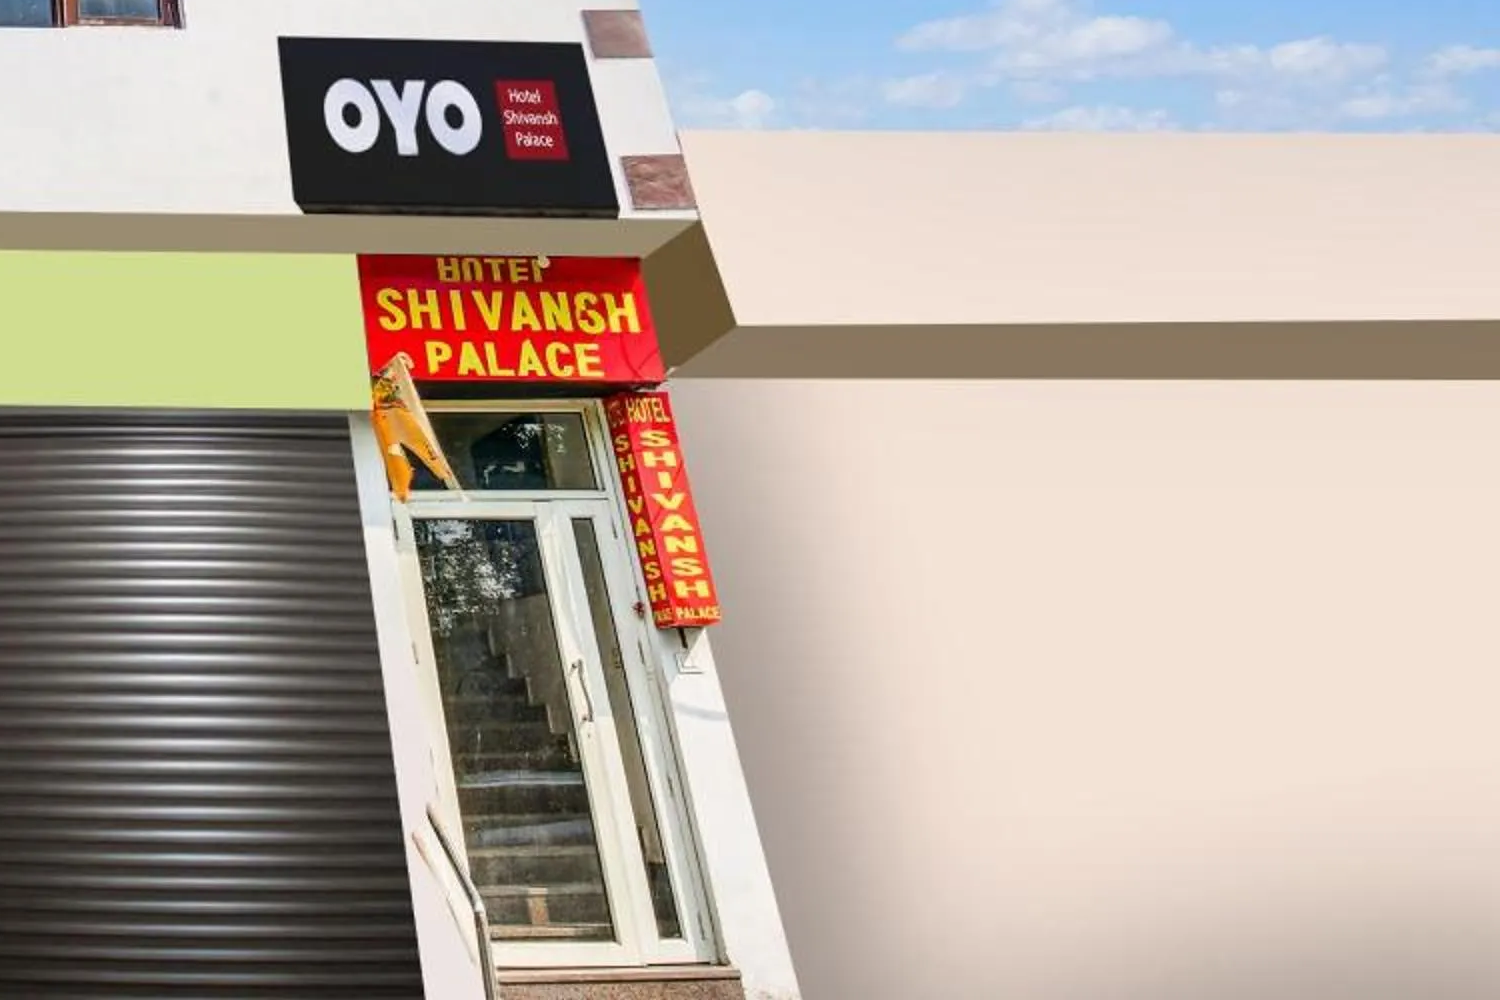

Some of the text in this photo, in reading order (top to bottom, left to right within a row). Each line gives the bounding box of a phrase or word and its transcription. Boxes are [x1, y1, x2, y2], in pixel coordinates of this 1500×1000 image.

[508, 88, 542, 104] Hotel
[323, 77, 483, 156] OYO
[503, 109, 559, 125] Shivansh
[515, 131, 554, 148] Palace
[376, 287, 641, 334] SHIVANSH
[425, 339, 605, 377] PALACE
[626, 397, 670, 424] HOTEL
[613, 435, 667, 603] SHIVANSH
[640, 431, 711, 598] SHIVANSH
[675, 605, 722, 620] PALACE
